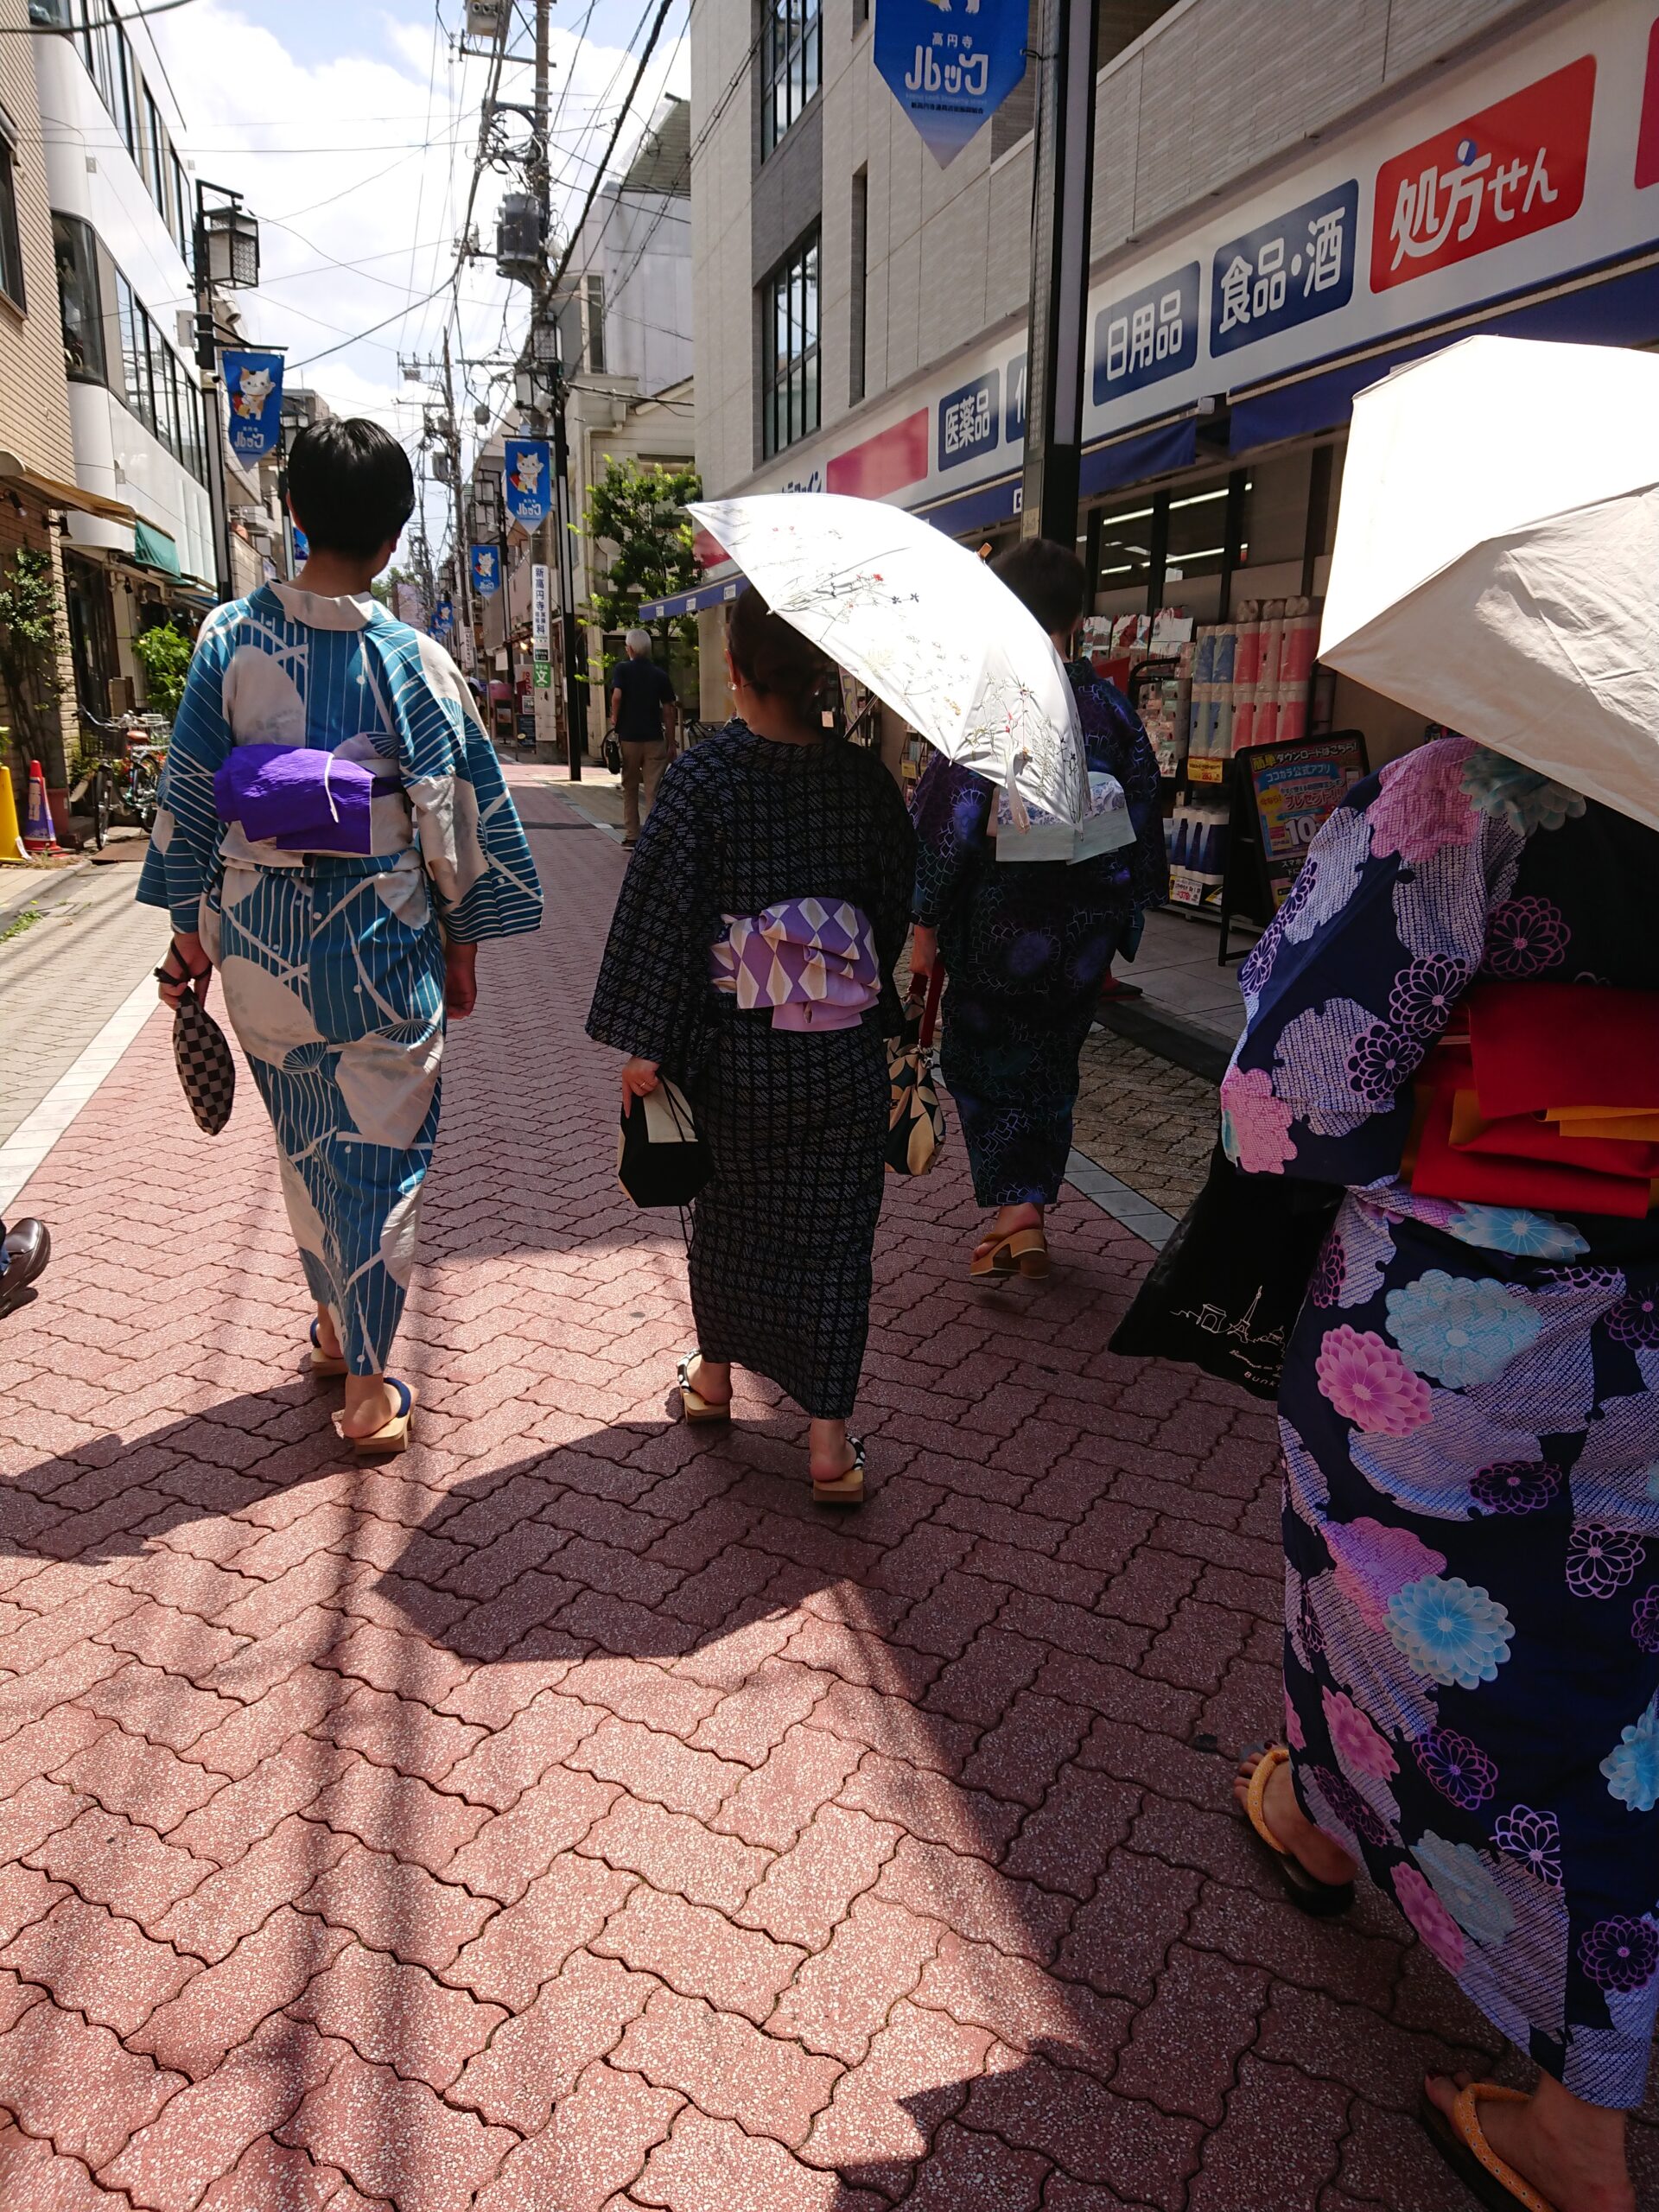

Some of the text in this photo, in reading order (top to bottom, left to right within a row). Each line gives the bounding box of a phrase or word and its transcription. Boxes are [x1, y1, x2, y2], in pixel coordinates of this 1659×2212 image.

[905, 45, 988, 95] ルック
[932, 32, 973, 48] 高円寺
[1389, 138, 1558, 271] 処方せん
[1219, 207, 1345, 334] 食品・酒
[1107, 289, 1183, 381] 日用品
[945, 388, 990, 454] 医薬品
[1265, 764, 1332, 783] ココカラ公式アプリ
